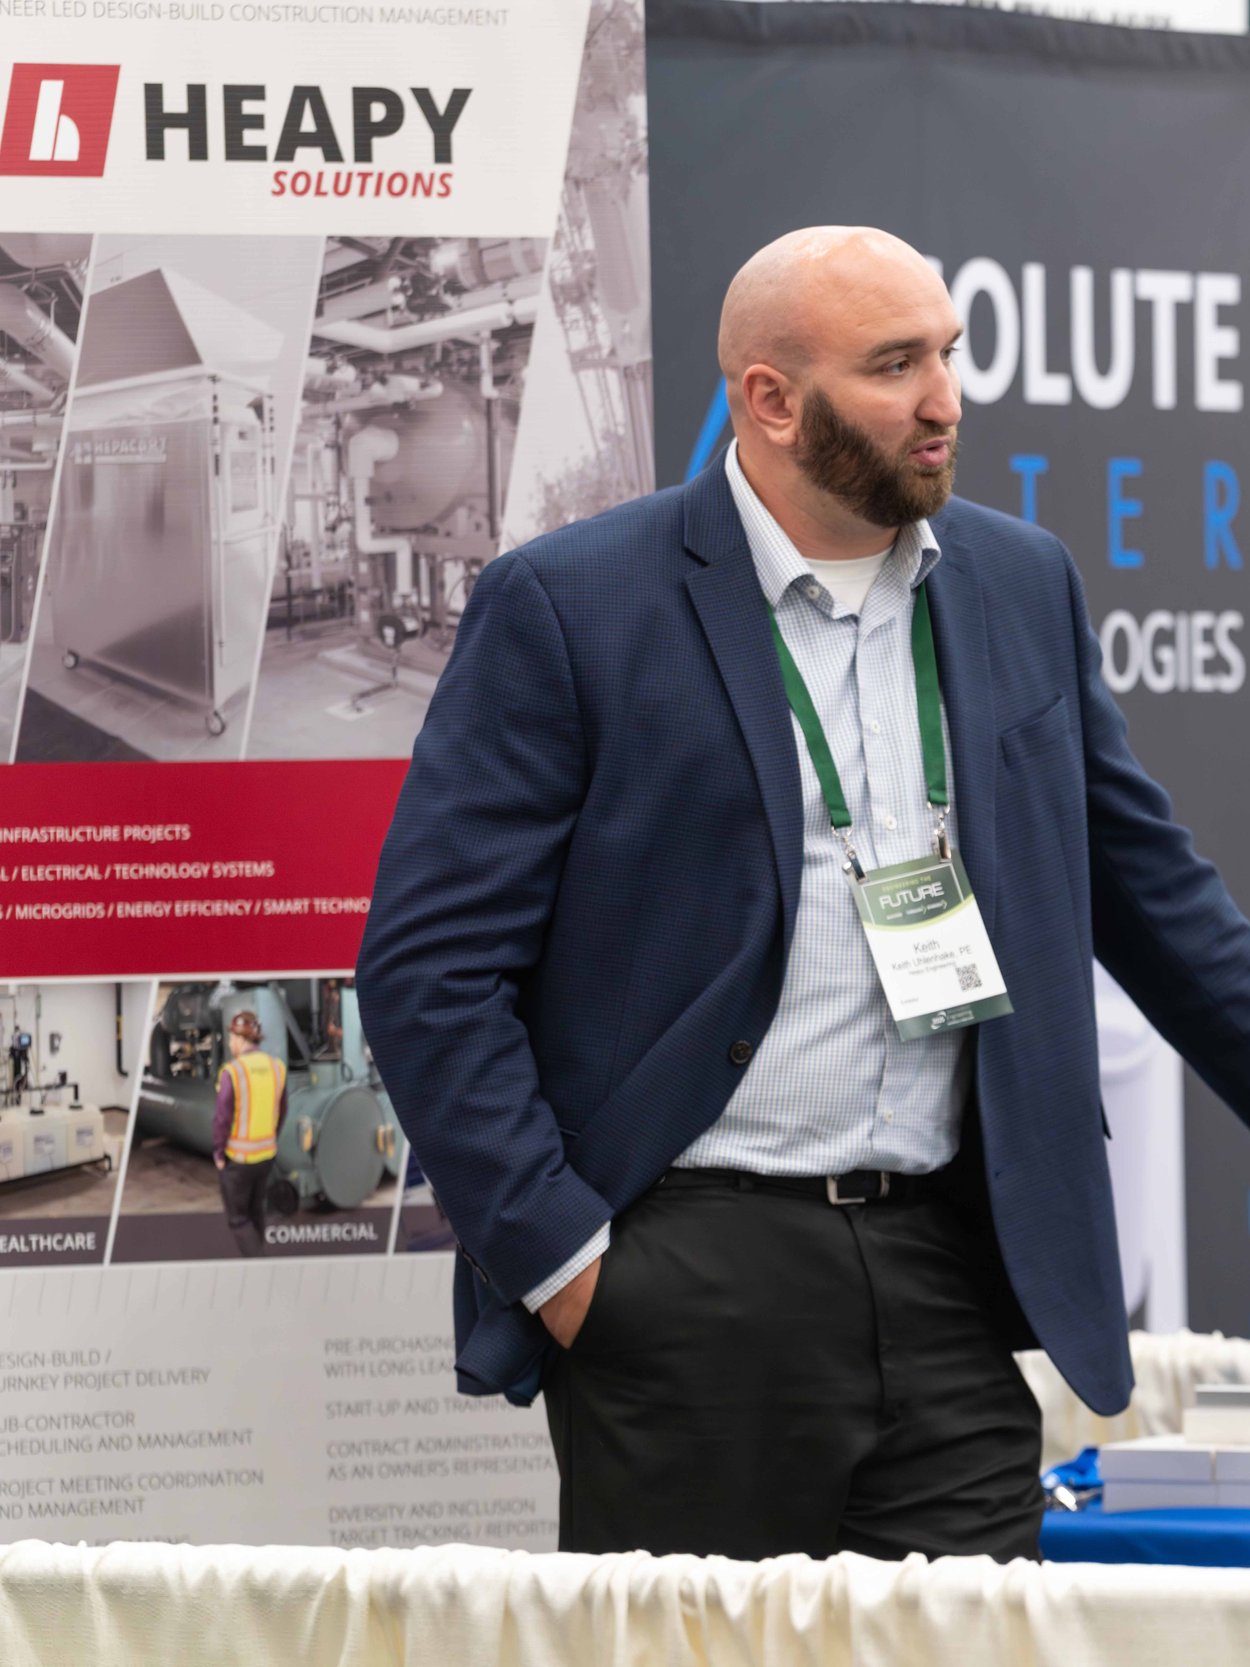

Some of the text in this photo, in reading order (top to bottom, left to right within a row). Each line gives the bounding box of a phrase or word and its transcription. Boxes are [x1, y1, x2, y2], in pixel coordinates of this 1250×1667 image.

[52, 0, 87, 18] LED
[92, 1, 224, 21] DESIGN-BUILD
[229, 4, 374, 24] CONSTRUCTION
[380, 7, 510, 26] MANAGEMENT
[143, 82, 473, 163] HEAPY
[271, 169, 455, 198] SOLUTIONS
[925, 256, 1243, 412] OLUTE
[1101, 610, 1245, 693] OGIES
[0, 824, 191, 843] INFRASTRUCTURE PROJECTS
[21, 864, 102, 882] ELECTRICAL
[114, 861, 209, 880] TECHNOLOGY
[213, 860, 275, 878] SYSTEMS
[879, 881, 945, 910] FUTURE
[15, 902, 105, 920] MICROGRIDS
[116, 901, 171, 918] ENERGY
[175, 899, 252, 917] EFFICIENCY
[263, 898, 310, 915] SMART
[313, 896, 371, 914] TECHNO
[914, 940, 940, 954] Keith
[0, 1232, 96, 1253] EALTHCARE
[265, 1223, 378, 1245] COMMERCIAL
[64, 1370, 131, 1392] PROJECT
[136, 1367, 211, 1388] DELIVERY
[324, 1361, 365, 1378] WITH
[369, 1360, 415, 1377] LONG
[325, 1398, 400, 1419] START-UP
[405, 1397, 439, 1415] AND
[98, 1434, 132, 1452] AND
[137, 1428, 253, 1450] MANAGEMENT
[326, 1438, 411, 1459] CONTRACT
[60, 1474, 133, 1494] MEETING
[138, 1468, 265, 1490] COORDINATION
[328, 1465, 348, 1481] AS
[352, 1463, 374, 1480] AN
[28, 1497, 145, 1519] MANAGEMENT
[328, 1497, 537, 1524] DIVERSITY AND INCLUSION
[329, 1526, 389, 1545] TARGET
[393, 1523, 472, 1543] TRACKING
